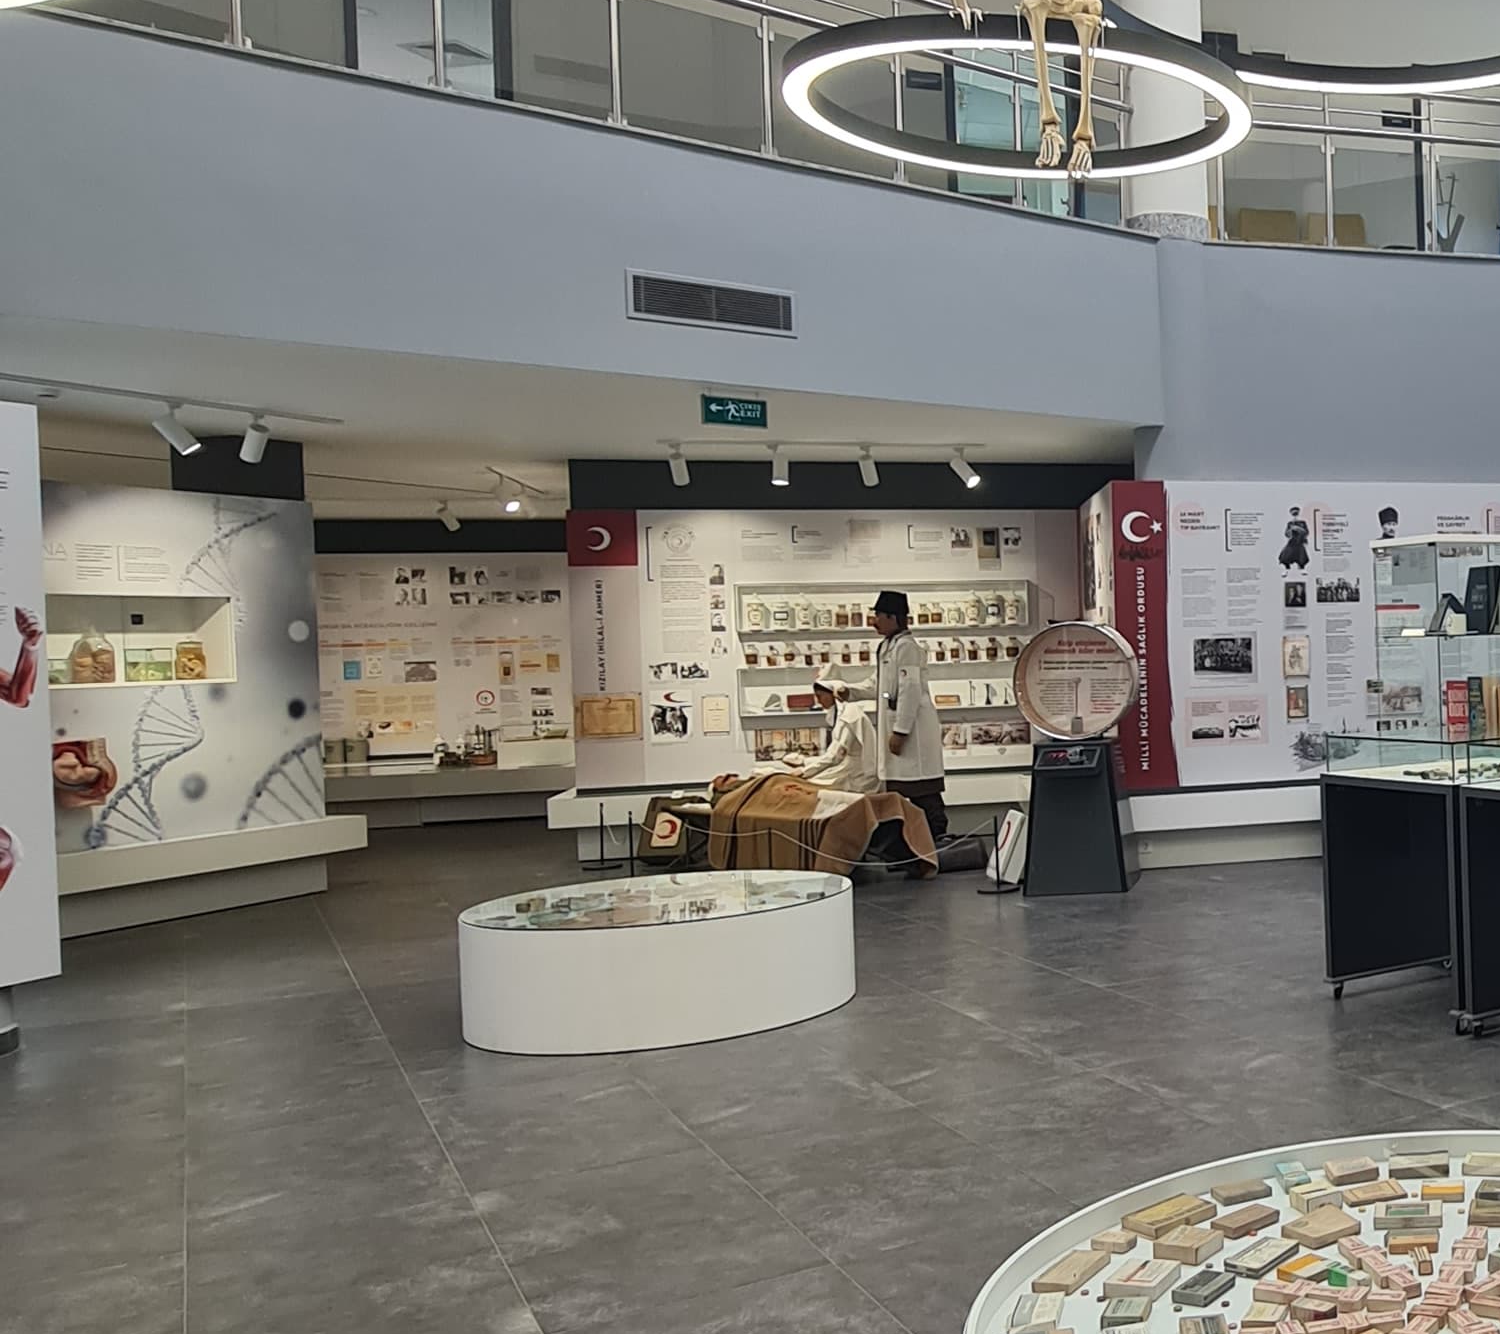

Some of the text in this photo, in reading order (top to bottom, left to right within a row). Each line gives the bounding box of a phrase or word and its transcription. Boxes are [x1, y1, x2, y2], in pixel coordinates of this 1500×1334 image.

[740, 410, 760, 418] EXIT
[597, 657, 606, 692] KIZILAY
[1135, 567, 1150, 771] MİLLİ MÜCADELENİN SAĞLIK ORDUSU
